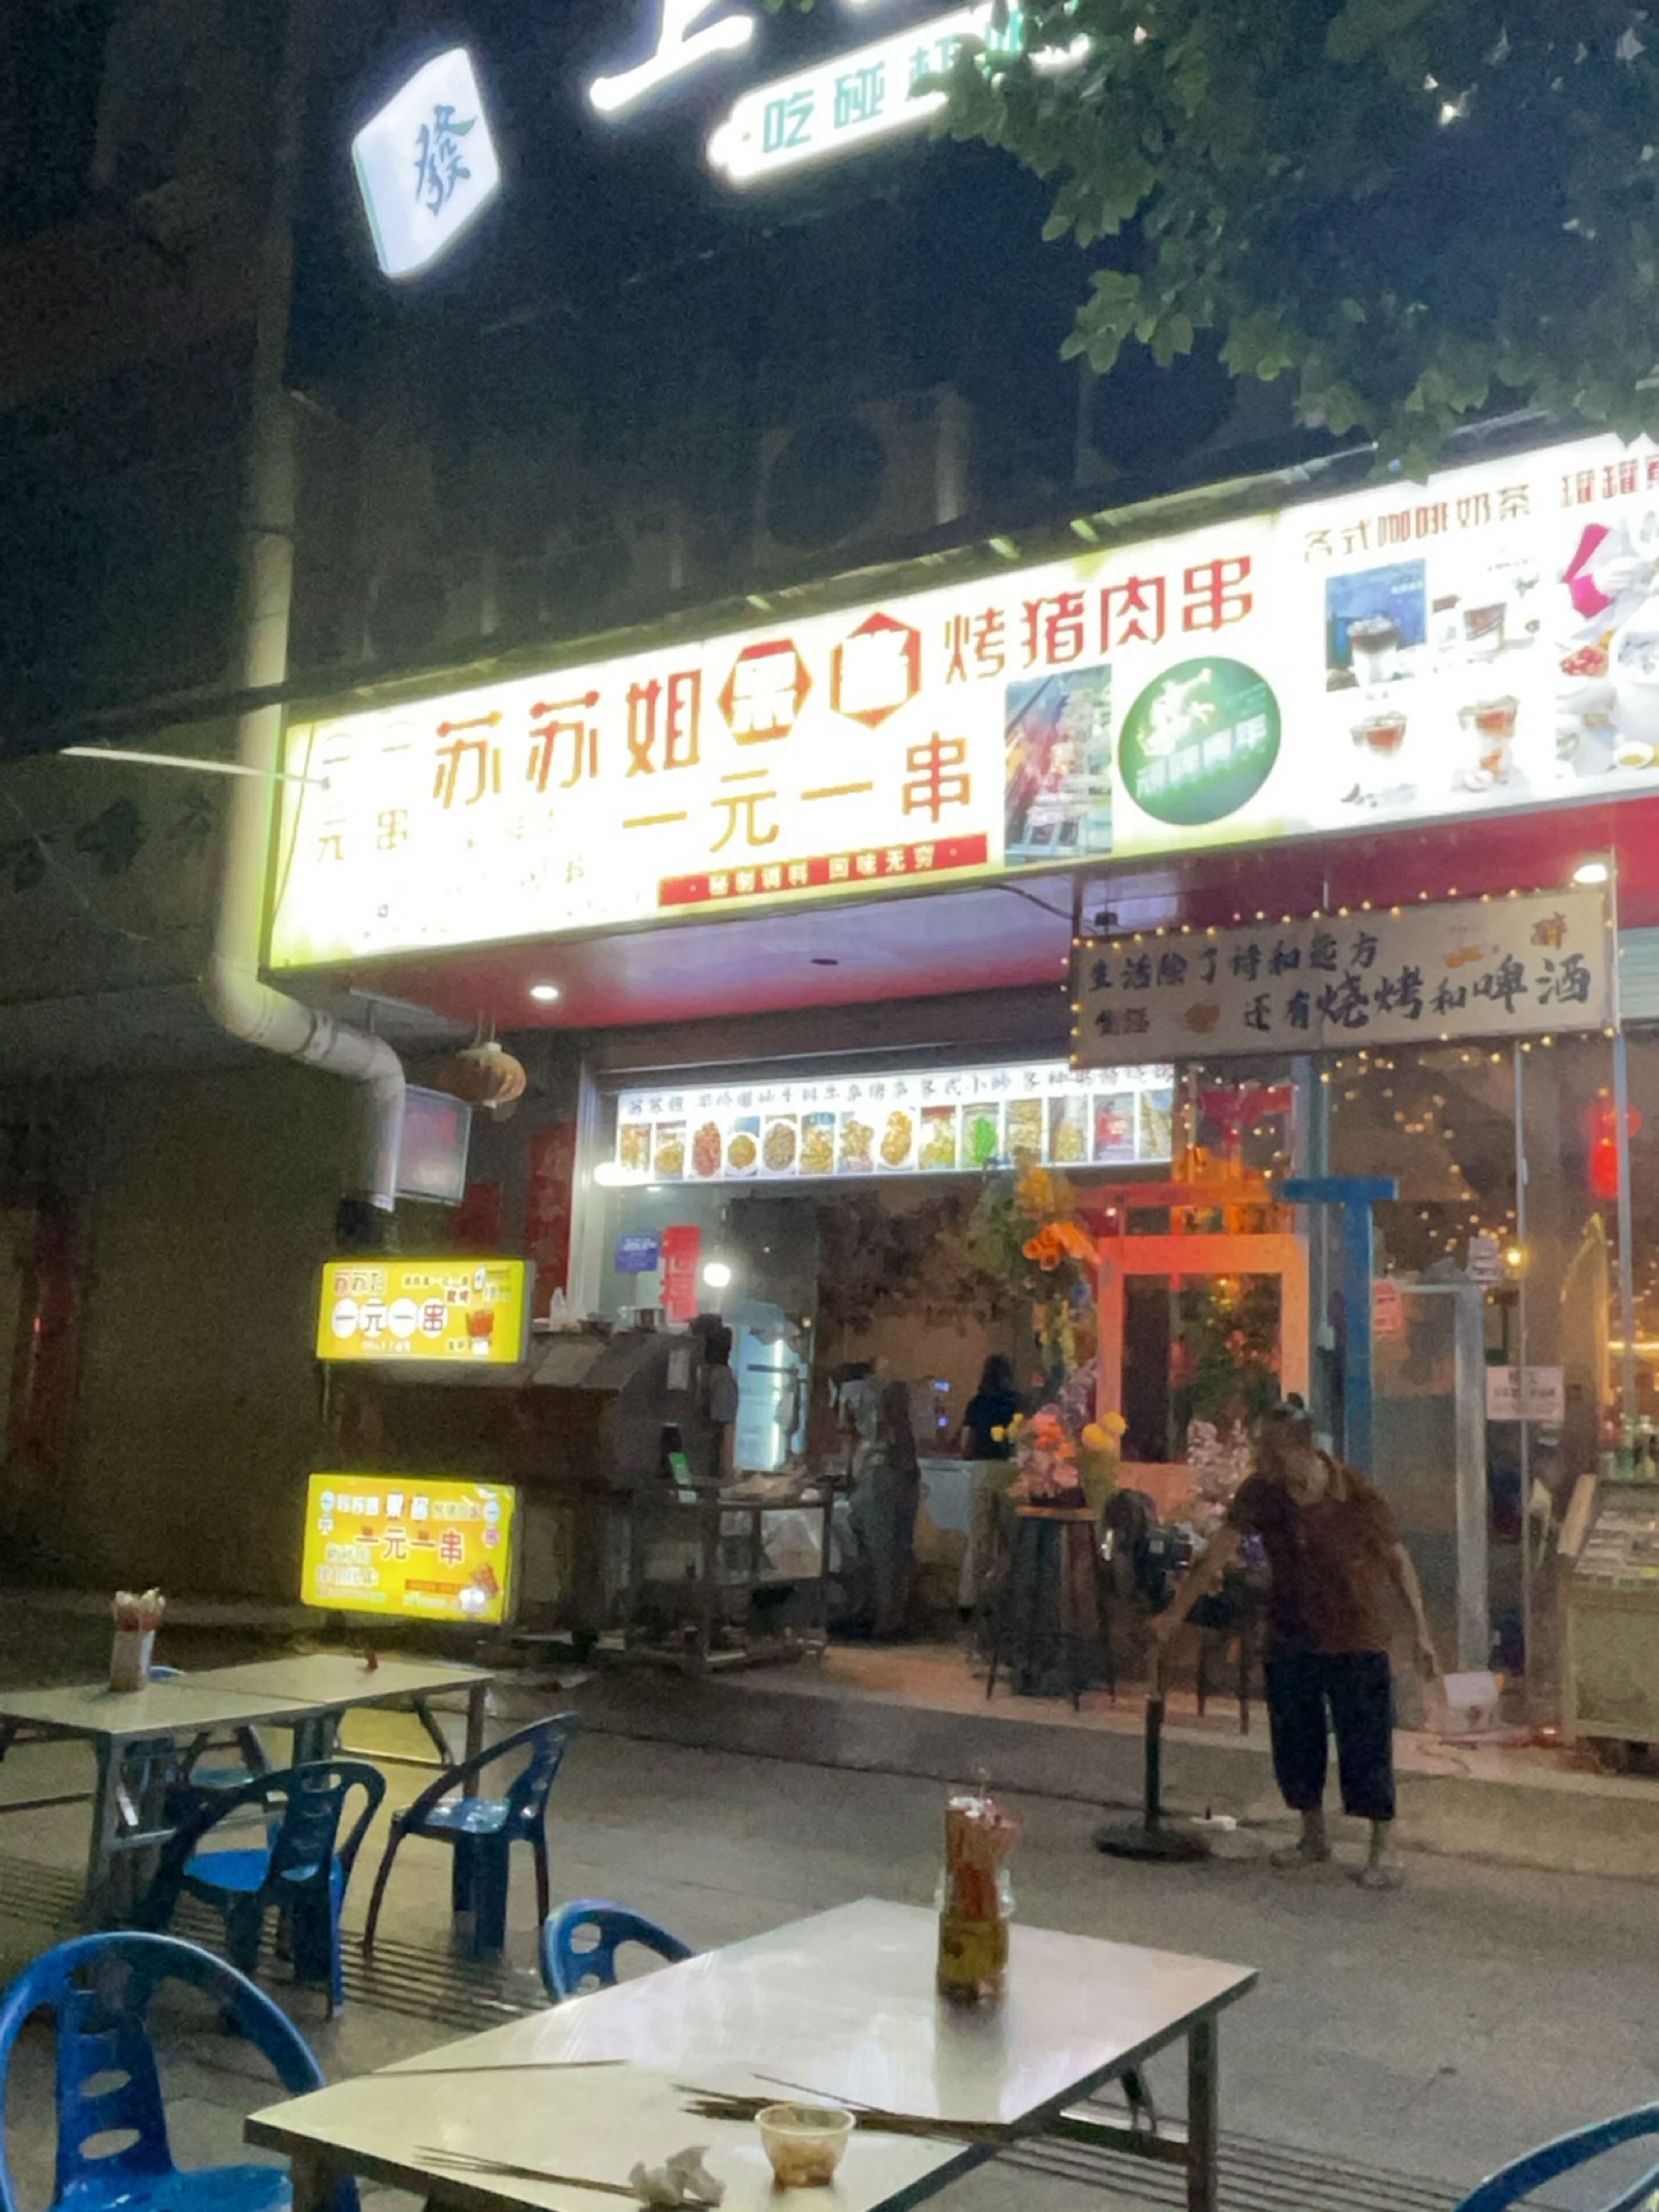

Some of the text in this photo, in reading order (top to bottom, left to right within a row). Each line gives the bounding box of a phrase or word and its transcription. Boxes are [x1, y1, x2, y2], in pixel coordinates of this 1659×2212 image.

[413, 104, 478, 217] 發
[1304, 483, 1530, 562] 各式咖啡奶茶
[944, 556, 1253, 685] 烤猪肉串
[433, 669, 701, 809] 苏苏姐
[622, 731, 970, 854] 一元一串
[828, 843, 936, 879] 回味无穷
[1089, 931, 1380, 993] 生活除了诗和远方
[1242, 952, 1591, 1031] 还有烧烤和啤酒
[335, 1302, 445, 1332] 一元一串
[355, 1528, 463, 1564] 一元一串
